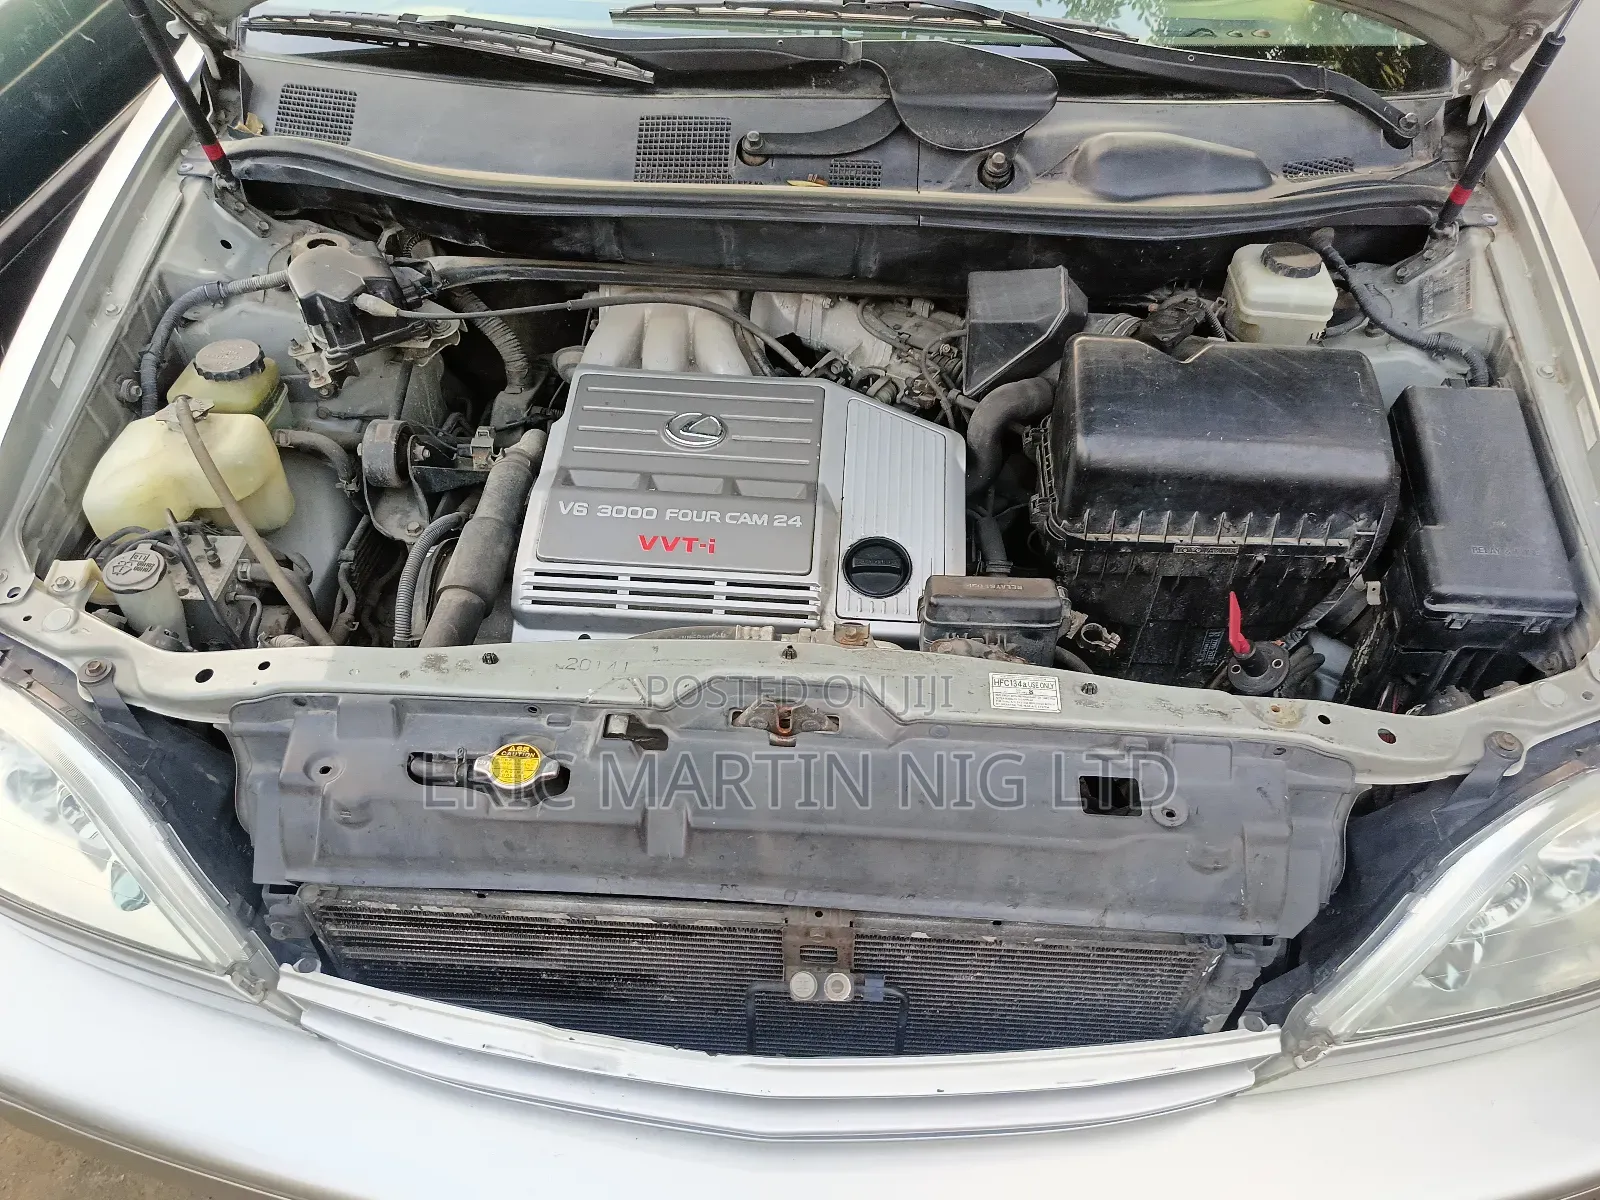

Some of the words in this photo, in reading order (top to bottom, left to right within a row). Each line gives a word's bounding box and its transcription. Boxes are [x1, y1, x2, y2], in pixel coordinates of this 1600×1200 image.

[558, 501, 589, 516] V6
[597, 504, 658, 519] 3000
[665, 508, 721, 523] FOUR
[725, 512, 769, 526] CAM
[773, 514, 803, 527] 24
[638, 534, 716, 554] VVT-i
[500, 750, 536, 758] CAUTION
